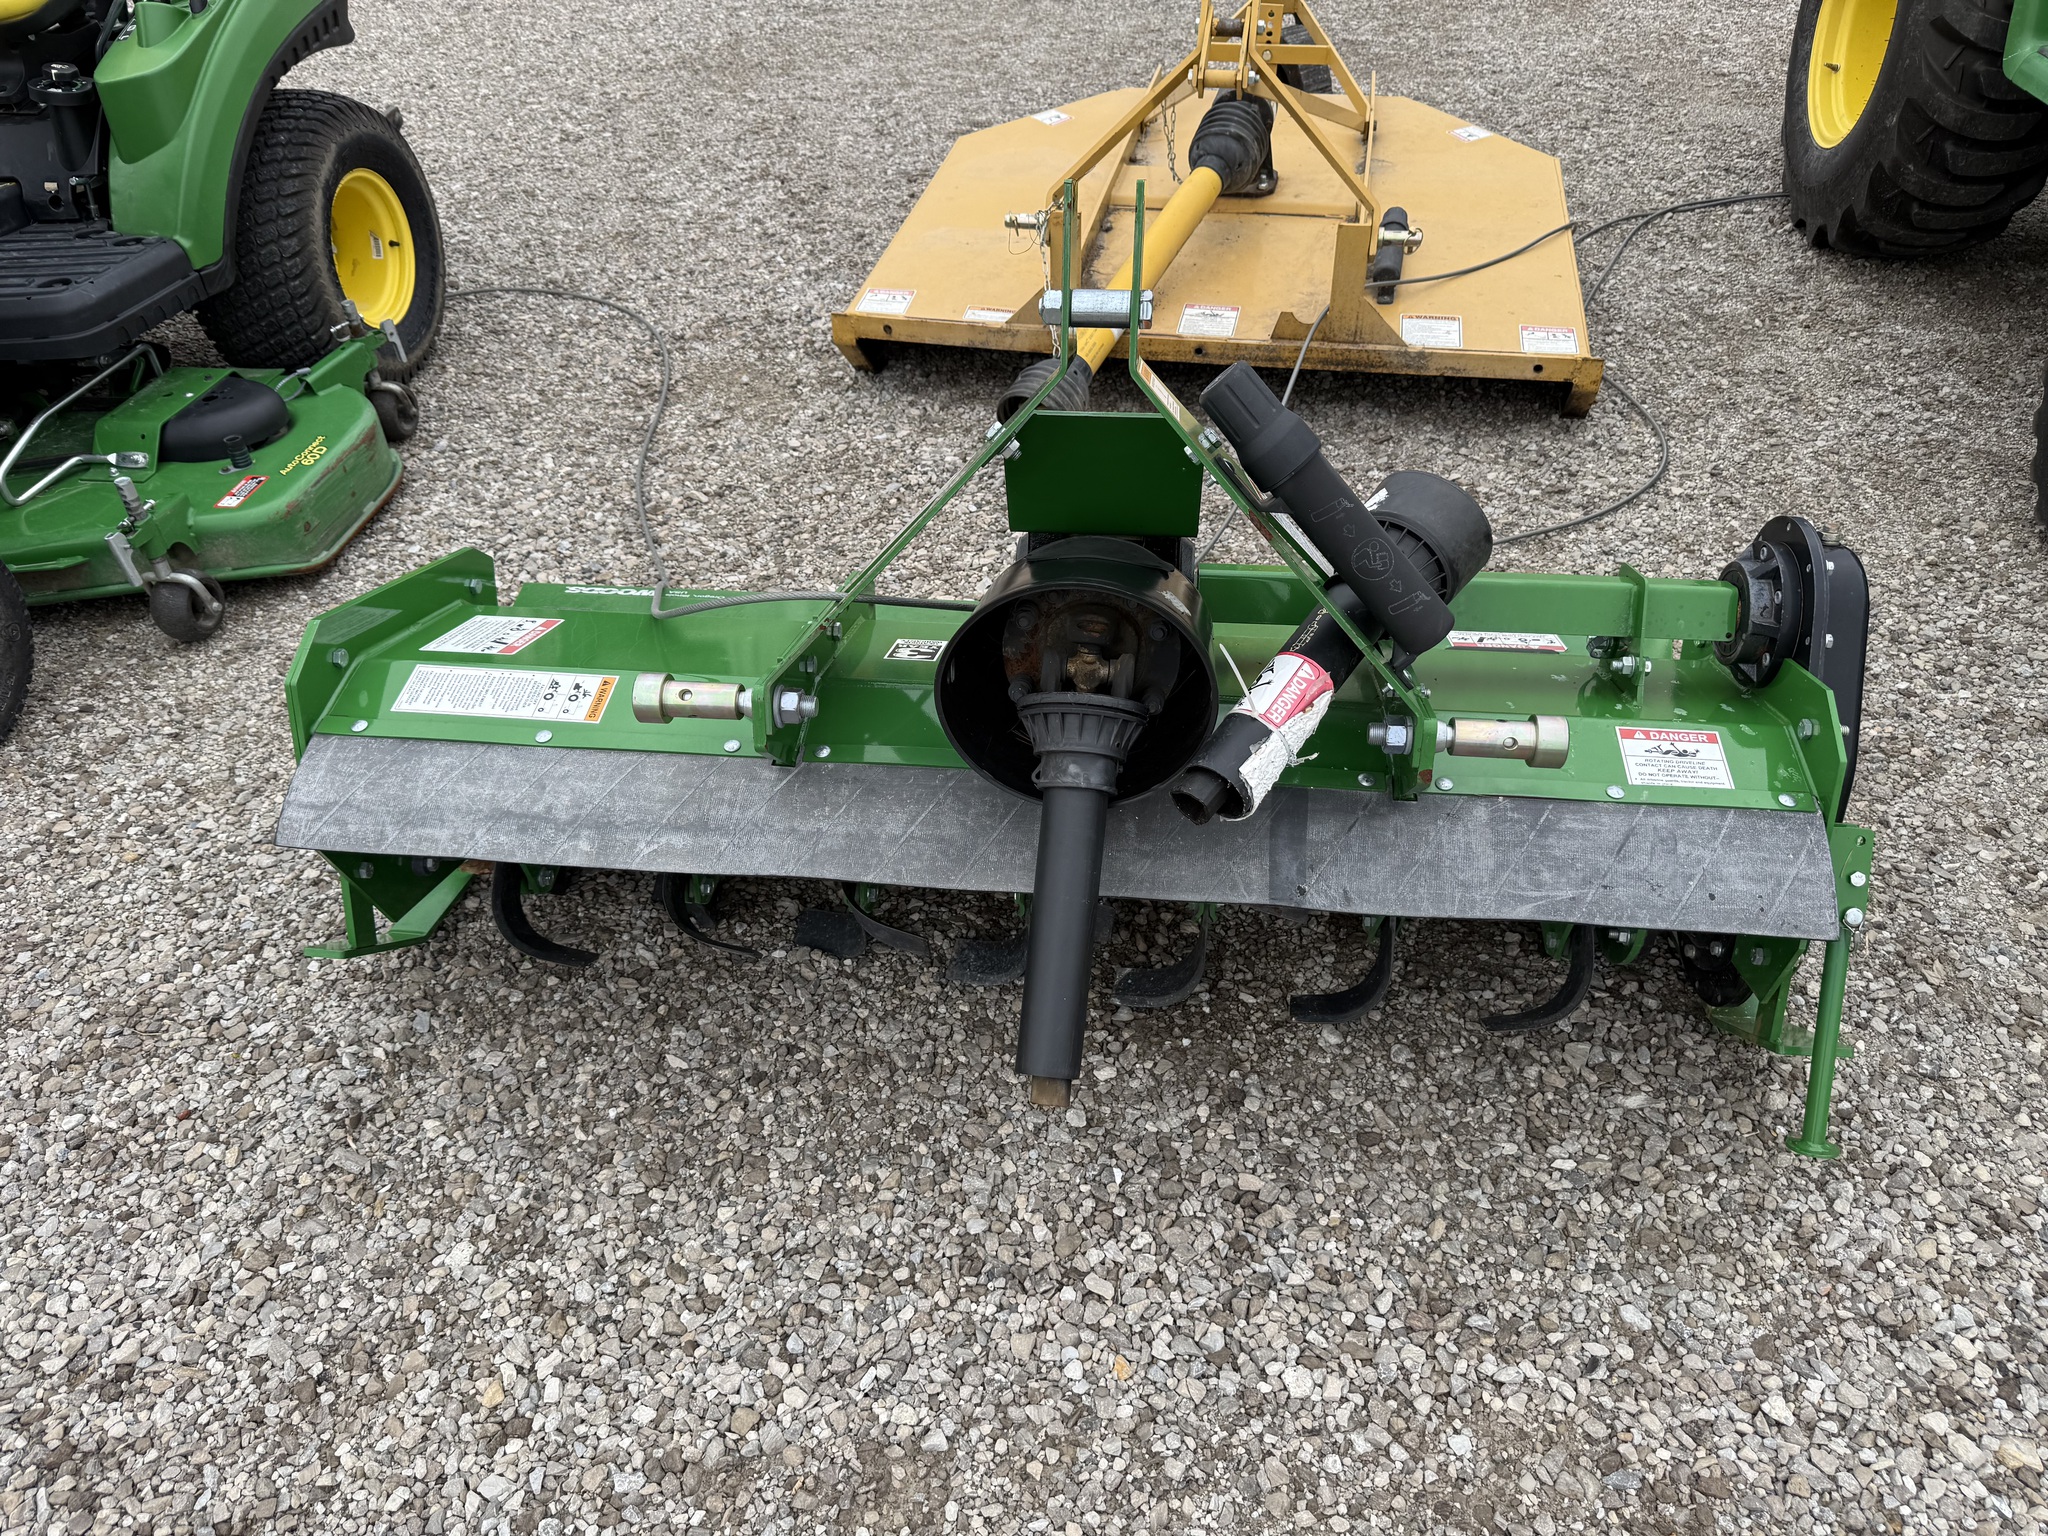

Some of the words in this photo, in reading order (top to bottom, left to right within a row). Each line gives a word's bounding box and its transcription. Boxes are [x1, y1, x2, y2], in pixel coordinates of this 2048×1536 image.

[279, 435, 325, 476] AutoConnect
[301, 445, 328, 466] 60D
[565, 586, 654, 597] WOODS
[588, 687, 607, 719] WARNING
[1267, 677, 1311, 724] DANGER
[1649, 731, 1709, 743] DANGER
